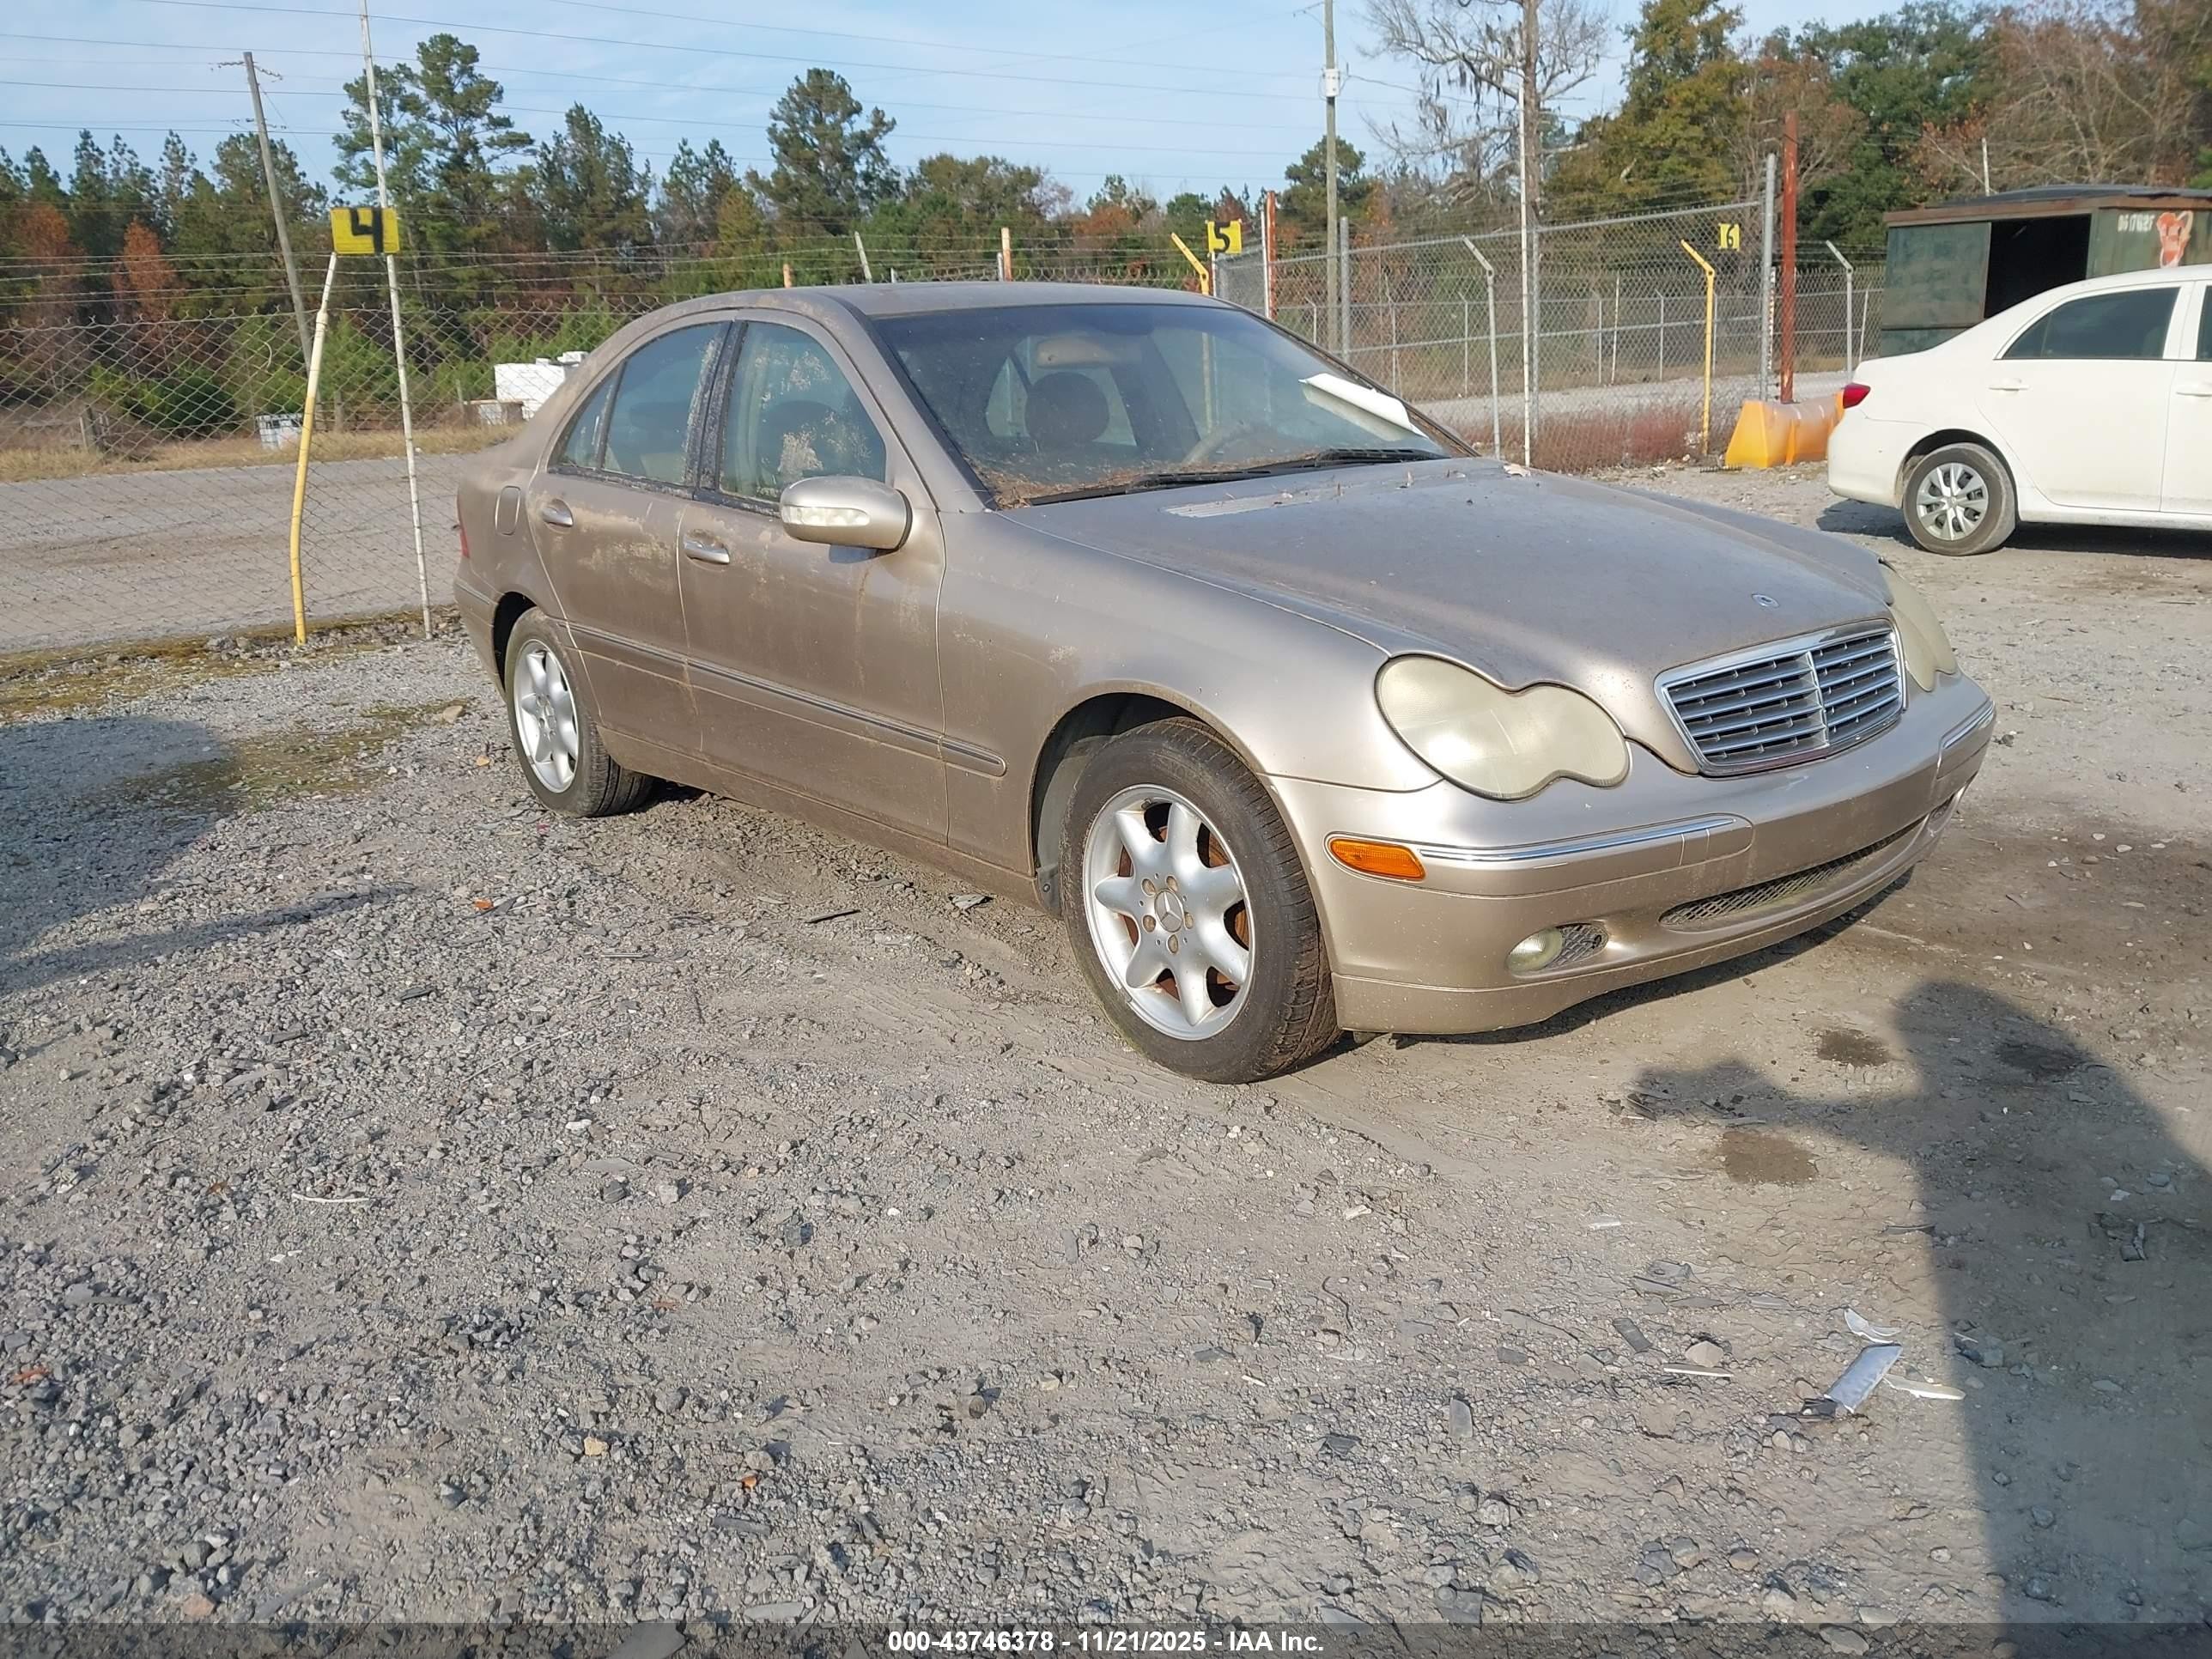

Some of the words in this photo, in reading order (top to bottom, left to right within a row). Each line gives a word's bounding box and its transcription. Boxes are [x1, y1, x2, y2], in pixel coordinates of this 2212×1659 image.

[349, 207, 384, 254] 4
[1213, 221, 1231, 252] 5
[1726, 222, 1735, 248] 6
